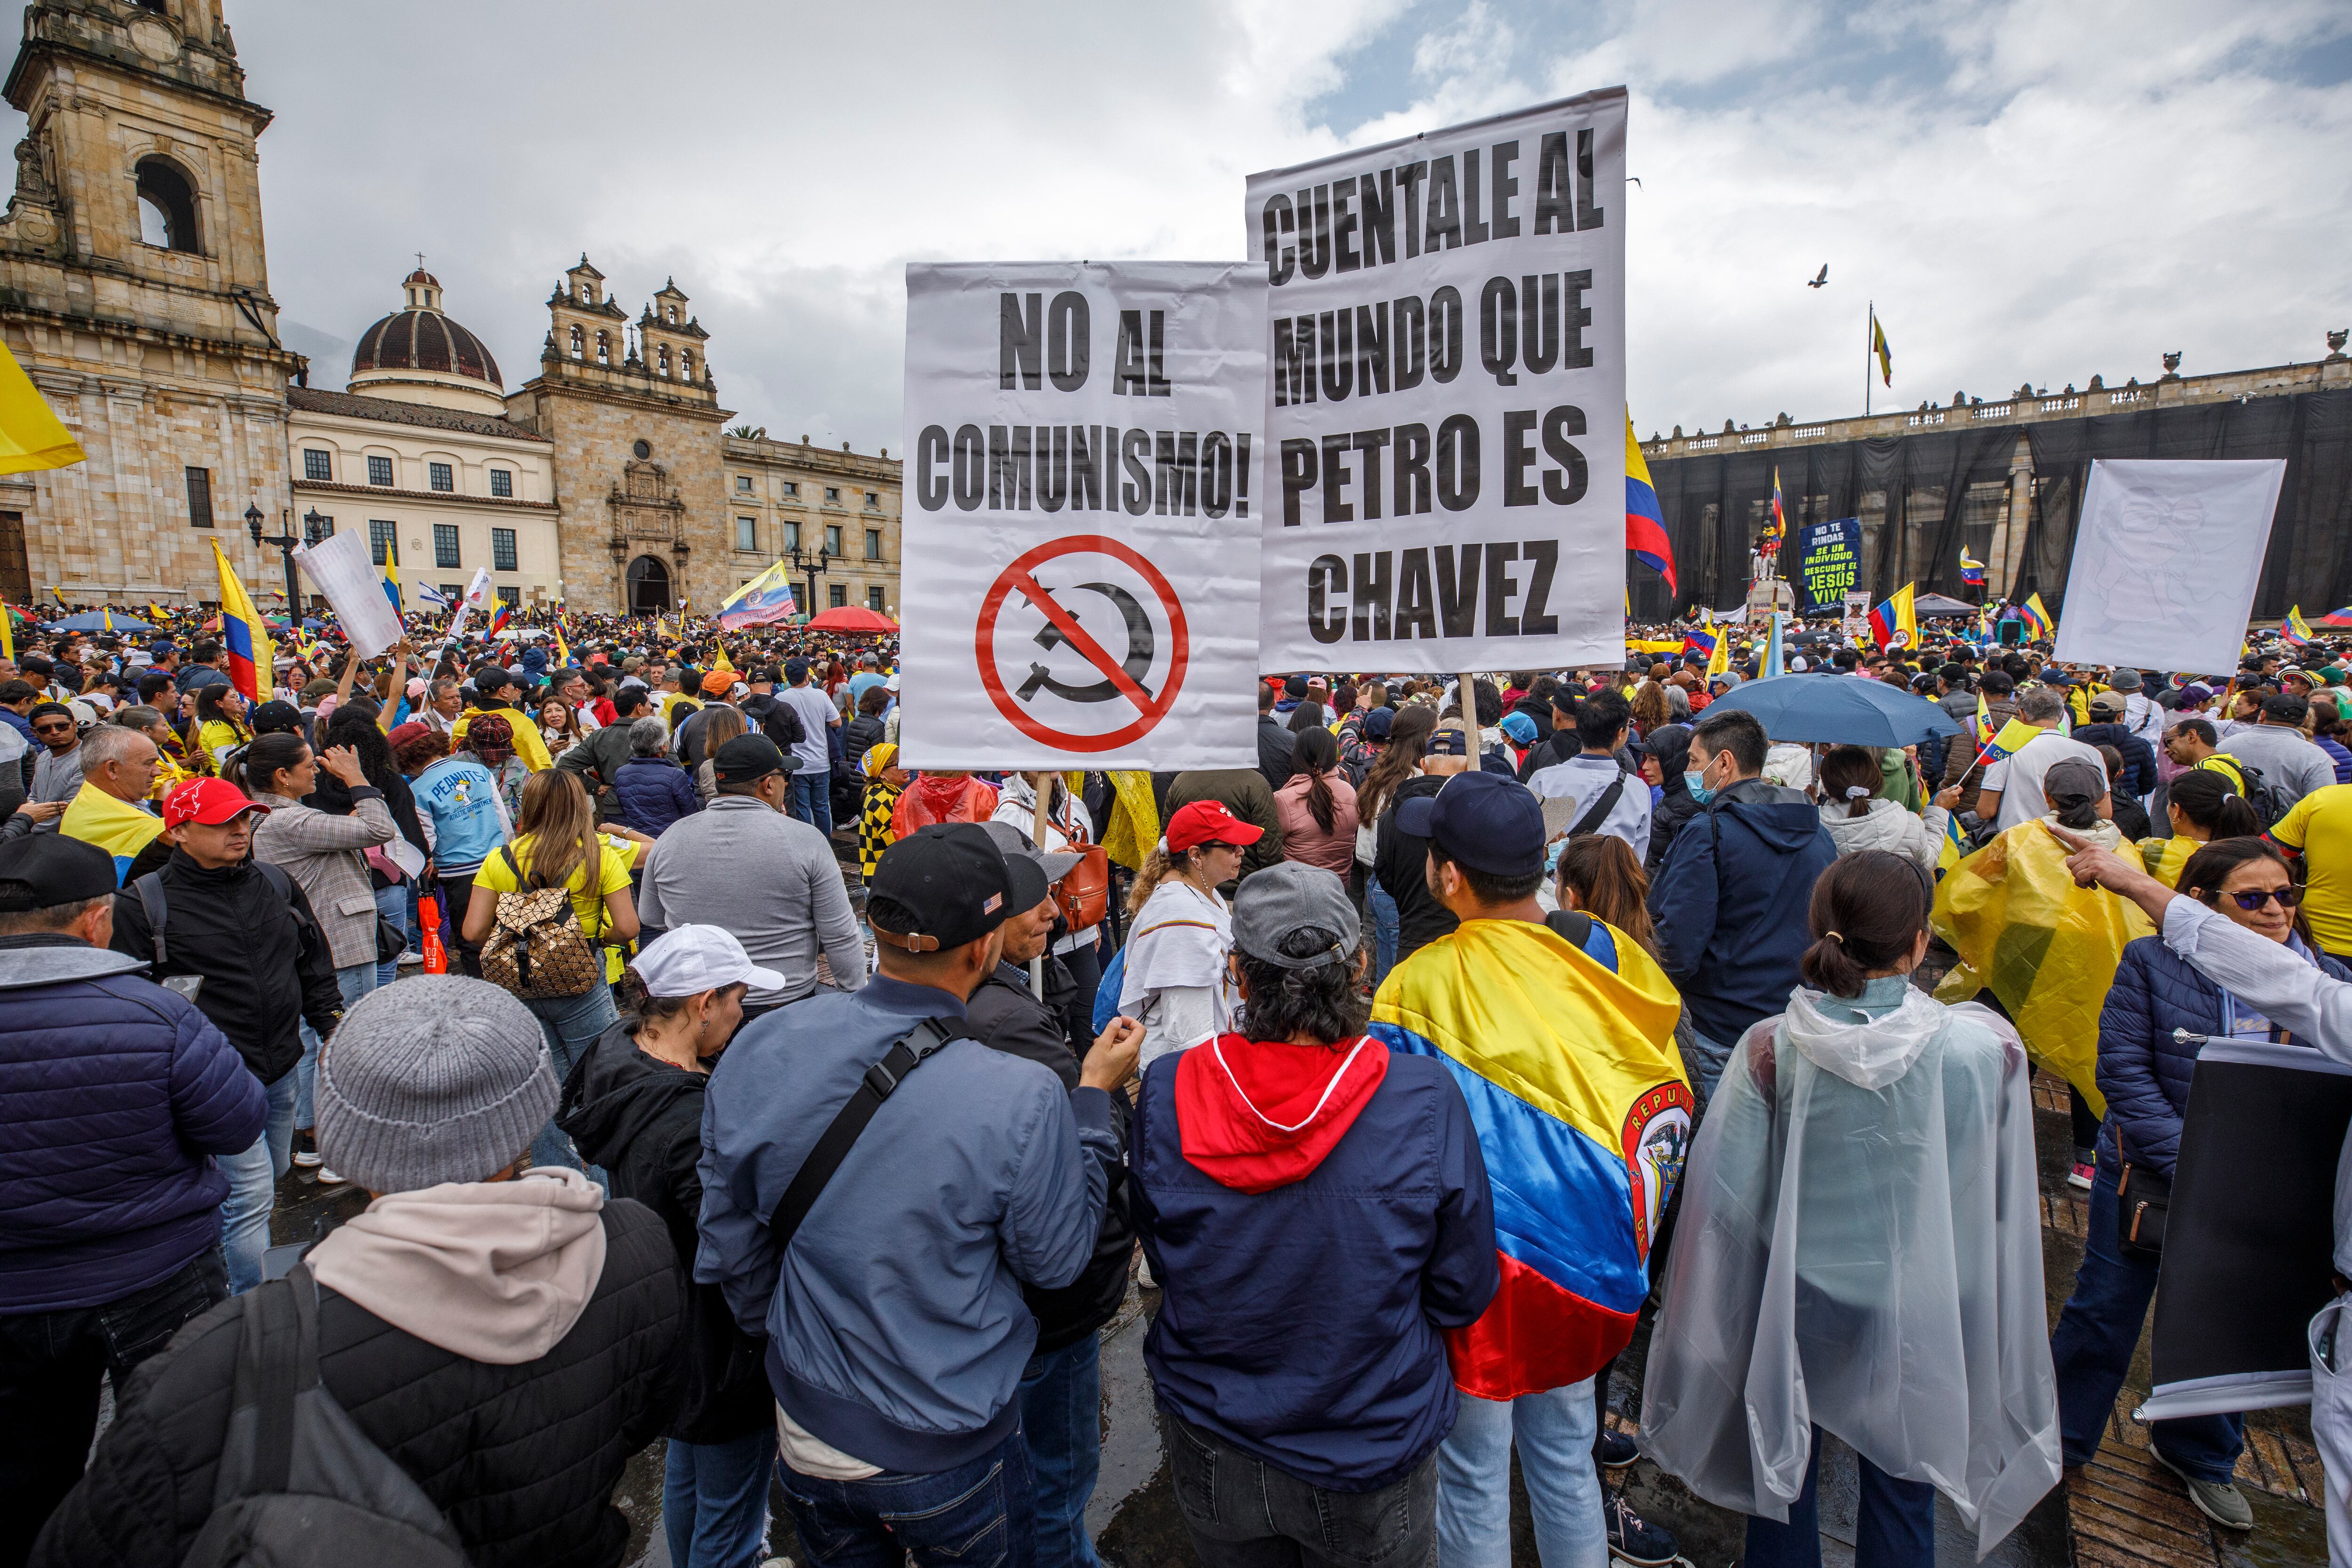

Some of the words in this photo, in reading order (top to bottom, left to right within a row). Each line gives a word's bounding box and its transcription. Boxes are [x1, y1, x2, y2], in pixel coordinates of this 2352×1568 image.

[1263, 140, 1520, 287] CUENTALE
[1534, 127, 1604, 235] AL
[1000, 291, 1090, 392] NO
[1112, 310, 1171, 397] AL
[1273, 285, 1463, 407] MUNDO
[1480, 269, 1594, 387] QUE
[917, 423, 1252, 520] COMUNISMO!
[1280, 413, 1481, 527] PETRO
[1503, 405, 1589, 506] ES
[1812, 532, 1844, 546] RINDAS
[1815, 525, 1827, 536] NO
[1830, 522, 1841, 532] TE
[1805, 551, 1853, 565] INDIVIDUO
[1831, 543, 1844, 553] UN
[1804, 563, 1846, 576] DESCUBRE
[1808, 571, 1855, 591] JESÚS
[1308, 539, 1559, 645] CHAVEZ
[1813, 587, 1848, 605] VIVO
[431, 770, 486, 803] PEANUTS
[449, 808, 467, 821] ATHLETIC
